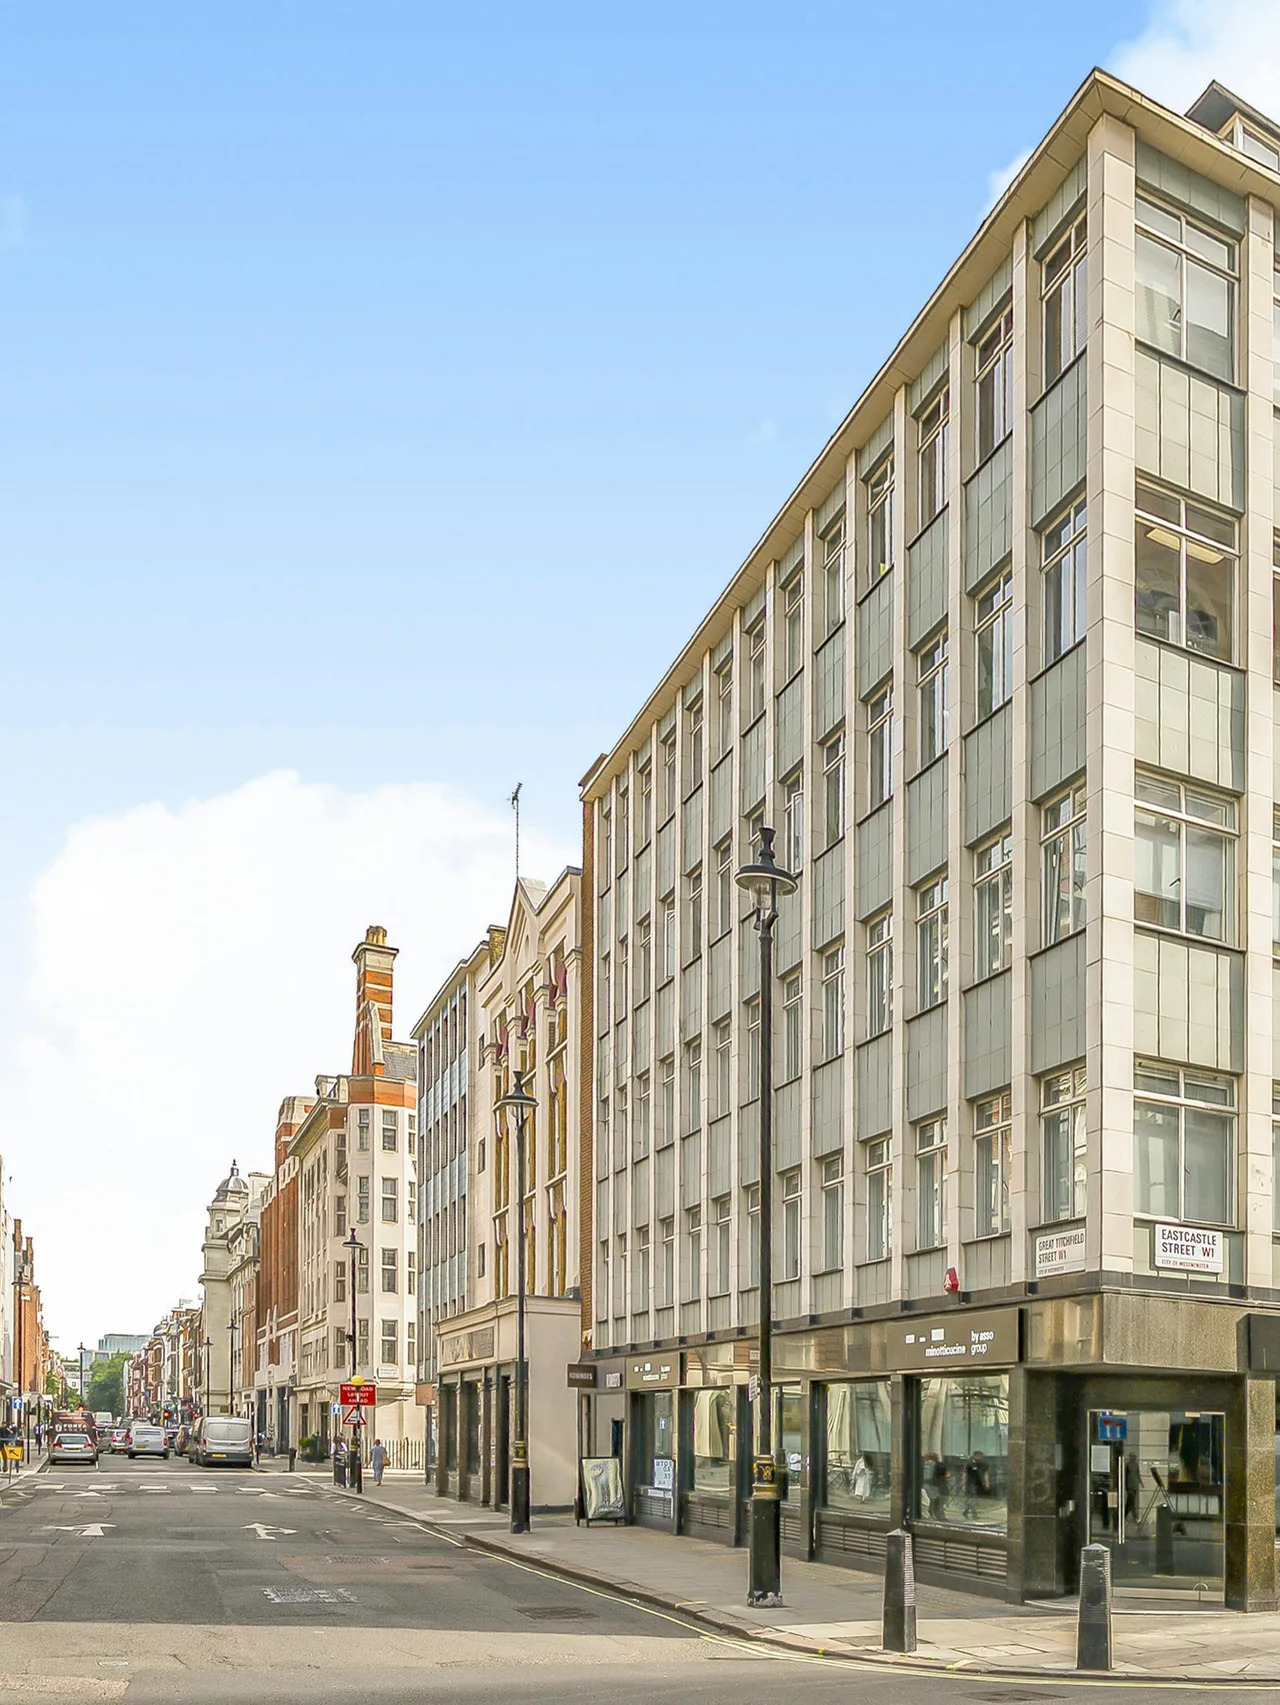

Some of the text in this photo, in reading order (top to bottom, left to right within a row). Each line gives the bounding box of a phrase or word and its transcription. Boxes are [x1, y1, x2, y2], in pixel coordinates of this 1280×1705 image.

[1039, 1233, 1084, 1251] GREAT TITCHFIELD
[1162, 1229, 1216, 1246] EASTCASTLE
[1039, 1249, 1066, 1264] STREET W1
[1162, 1242, 1214, 1258] STREET W1
[971, 1330, 979, 1342] by
[971, 1344, 987, 1355] group
